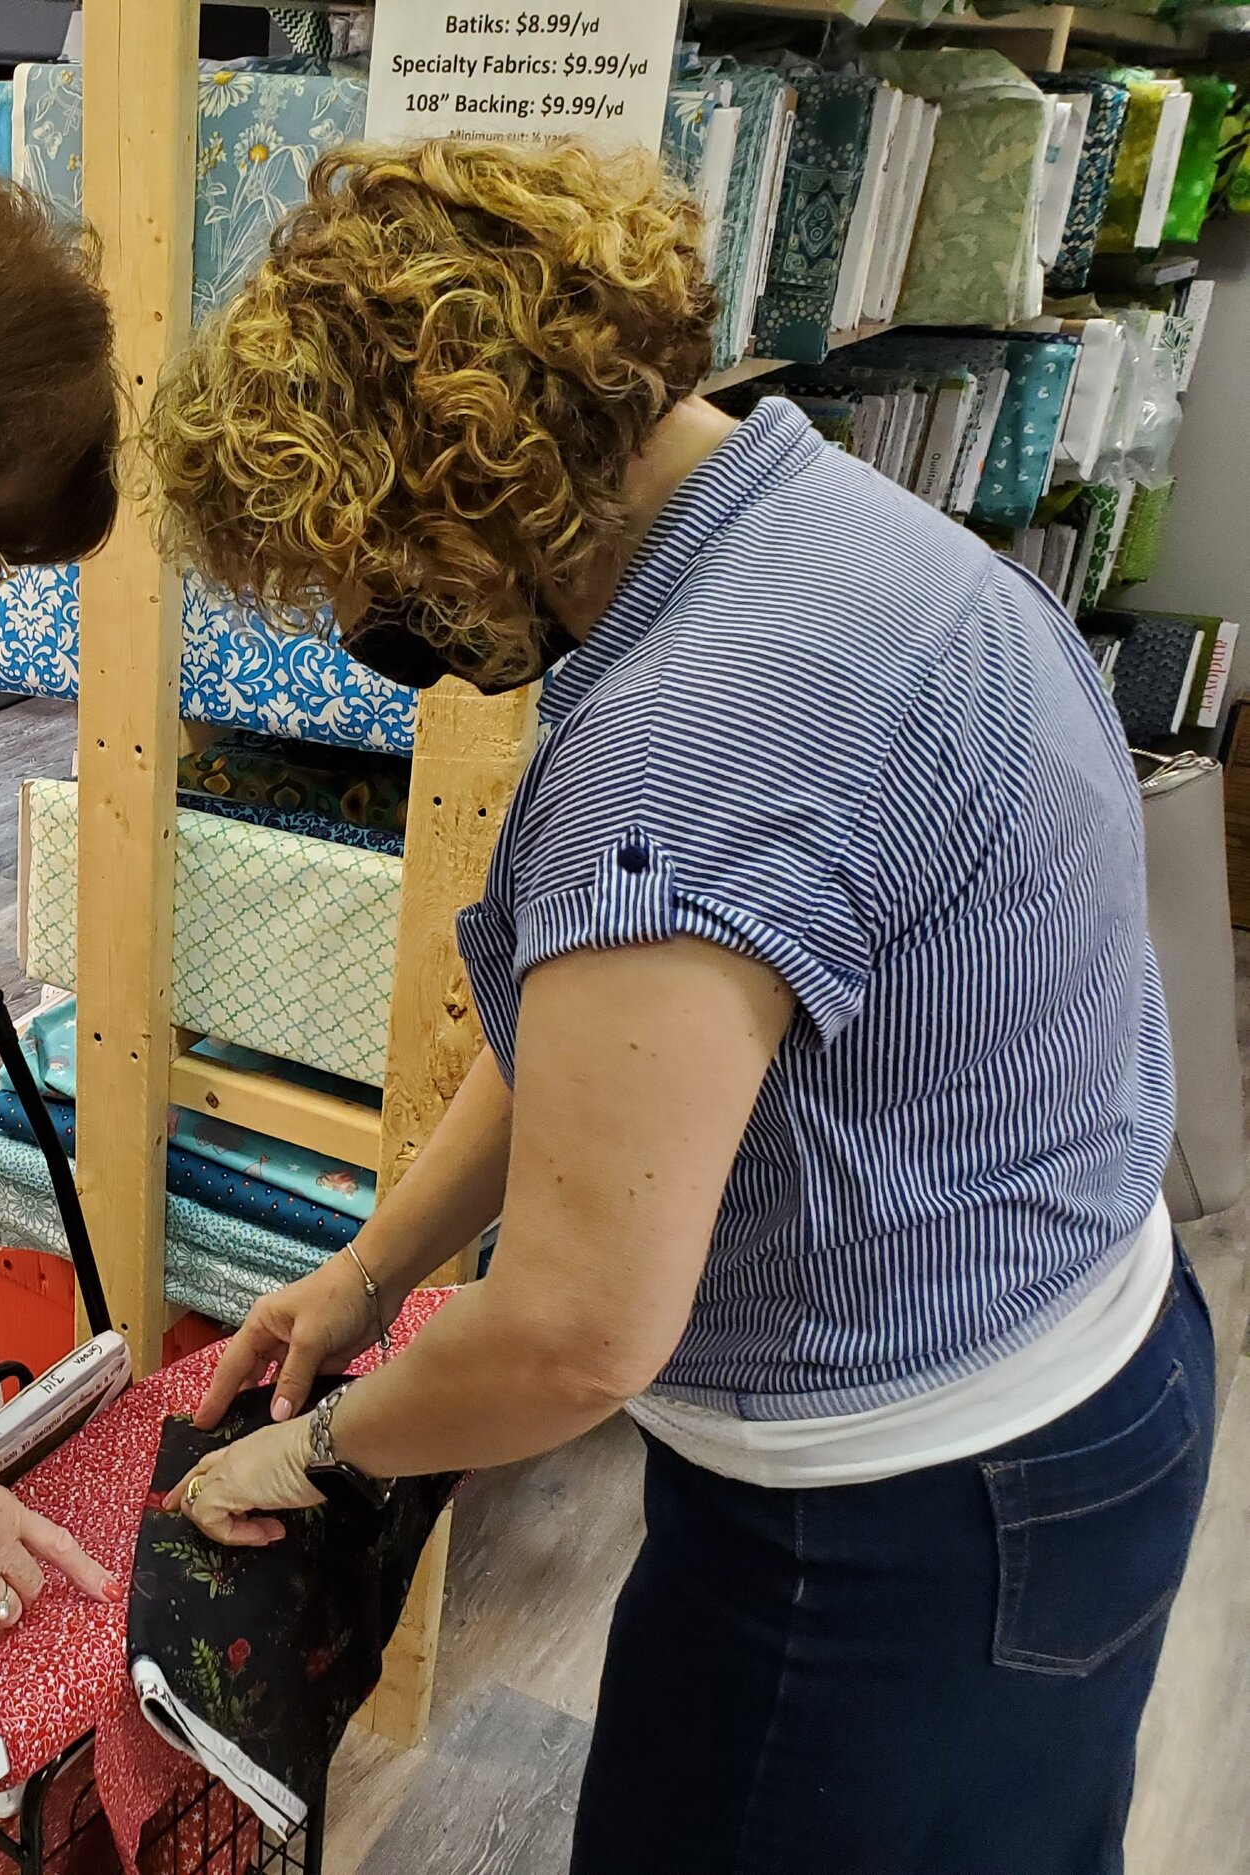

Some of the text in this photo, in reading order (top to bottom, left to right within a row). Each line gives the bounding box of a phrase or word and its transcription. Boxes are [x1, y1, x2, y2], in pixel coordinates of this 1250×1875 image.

[445, 11, 600, 37] Batiks: $8.99/yd
[391, 52, 648, 79] Specialty Fabrics: $9.99/yd
[455, 94, 535, 118] Backing:
[540, 94, 624, 120] $9.99/yd
[450, 129, 504, 142] Minimum
[922, 453, 942, 494] Quilting
[1200, 639, 1228, 713] andover
[39, 1373, 65, 1394] 314
